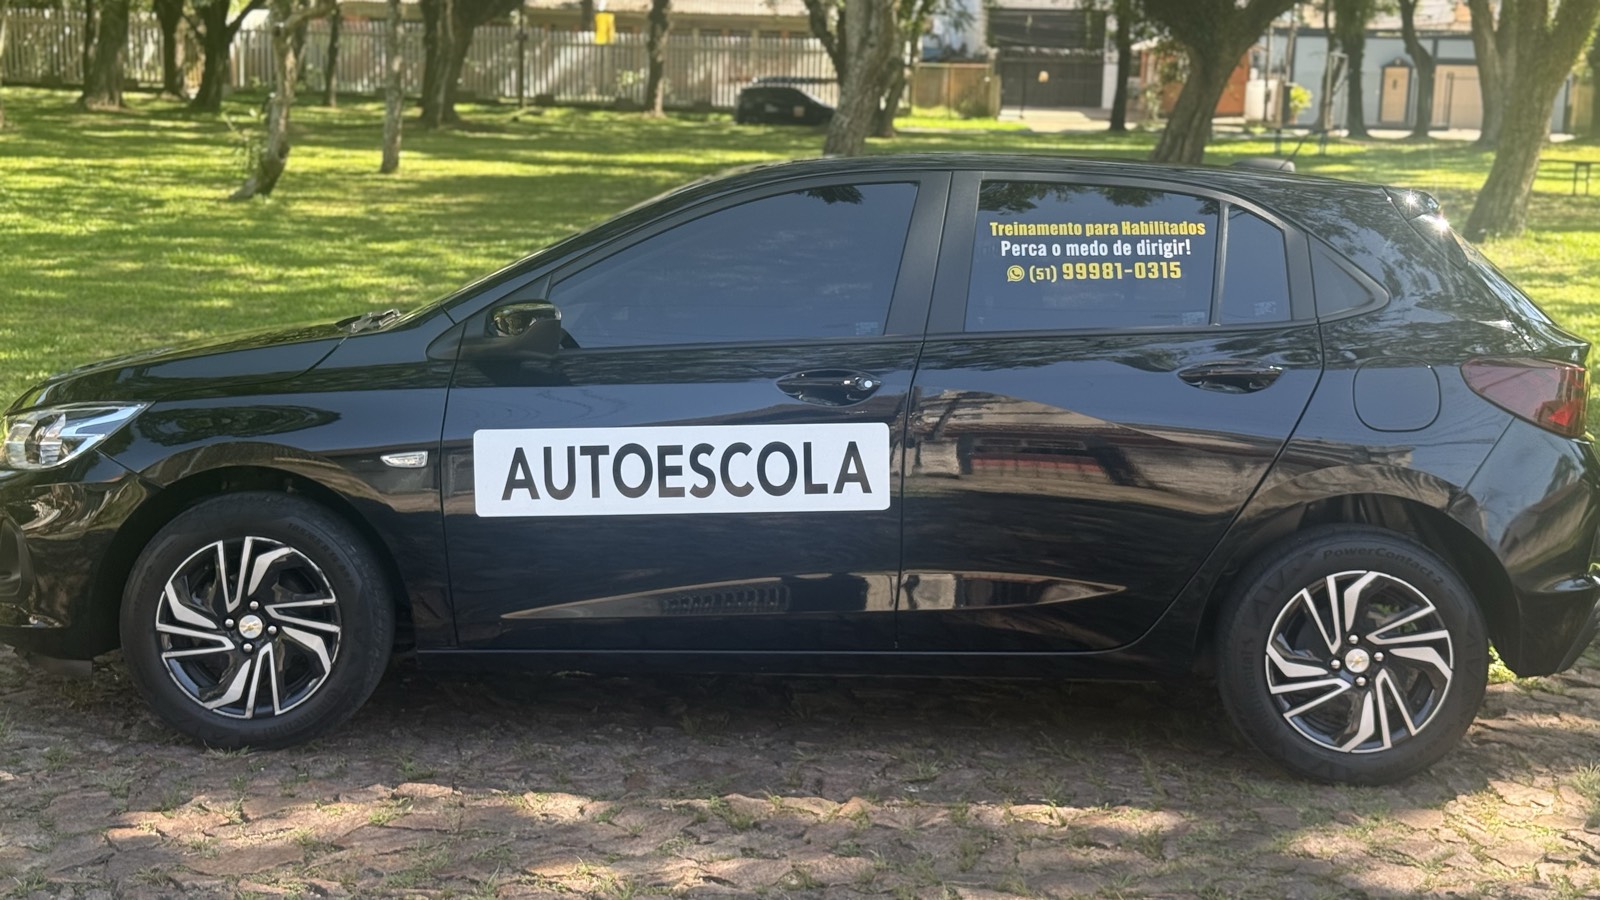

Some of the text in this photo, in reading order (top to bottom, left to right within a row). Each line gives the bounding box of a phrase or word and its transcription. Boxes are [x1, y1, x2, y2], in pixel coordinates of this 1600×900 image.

[989, 221, 1206, 237] Treinamento para Habilitados
[1000, 238, 1192, 259] Perca o medo de dirigir!
[1029, 261, 1182, 283] (51) 99981-0315
[501, 440, 873, 501] AUTOESCOLA
[1323, 547, 1435, 577] PowerContact
